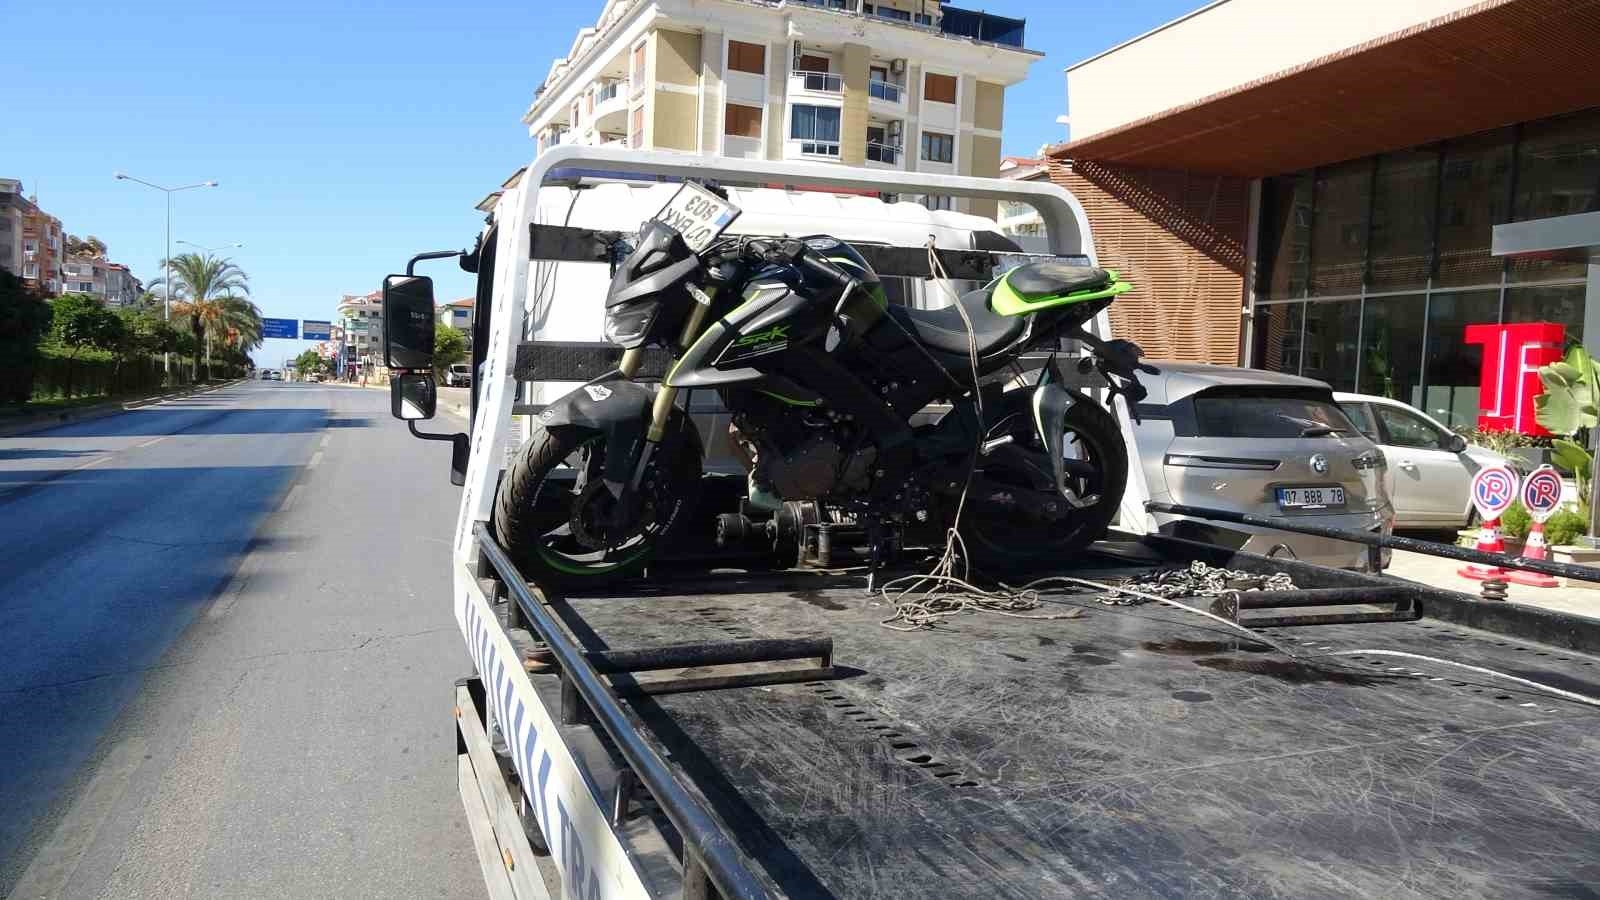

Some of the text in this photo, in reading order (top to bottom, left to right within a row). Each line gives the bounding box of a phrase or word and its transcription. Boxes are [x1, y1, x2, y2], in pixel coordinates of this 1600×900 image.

[1285, 489, 1343, 504] 07 BBB 78
